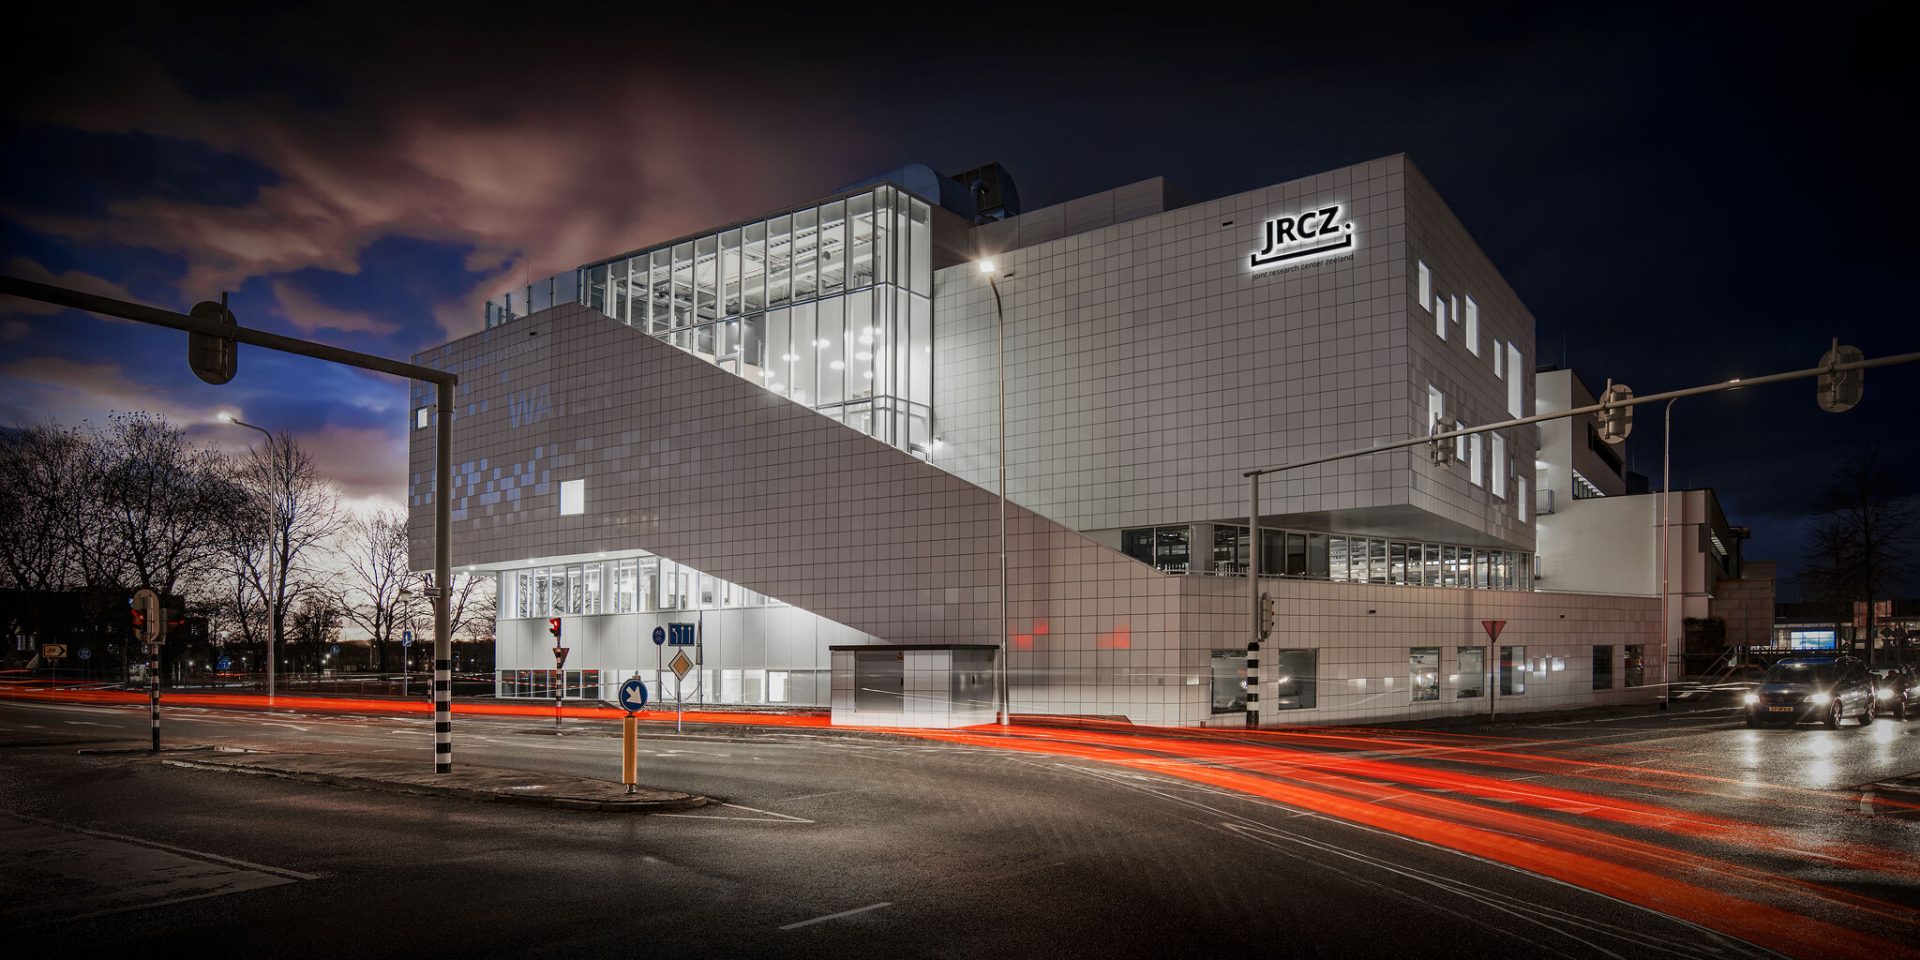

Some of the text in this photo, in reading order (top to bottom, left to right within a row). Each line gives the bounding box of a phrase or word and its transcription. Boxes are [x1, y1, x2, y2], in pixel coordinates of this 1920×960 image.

[1252, 253, 1353, 281] joint research center zeeland
